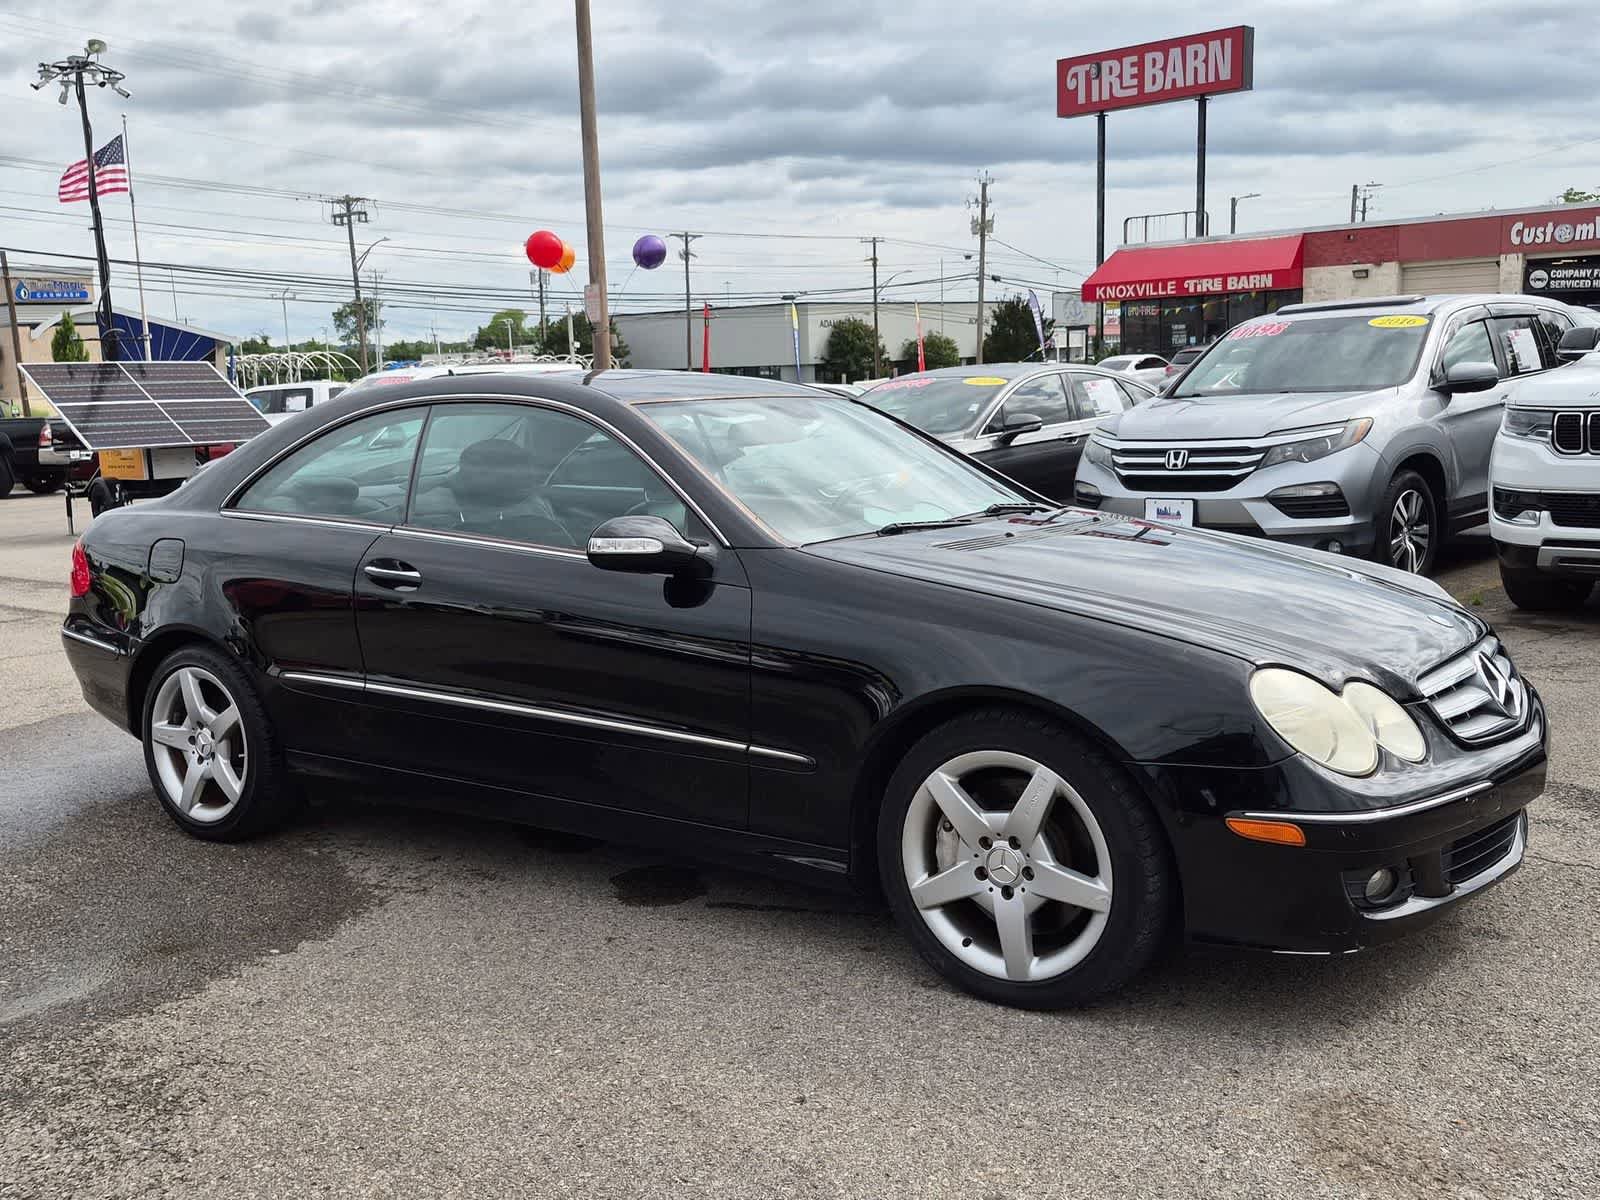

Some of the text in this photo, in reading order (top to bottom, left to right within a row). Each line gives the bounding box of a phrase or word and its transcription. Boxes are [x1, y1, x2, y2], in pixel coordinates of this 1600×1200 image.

[1144, 38, 1232, 94] BARN
[1511, 215, 1600, 245] Custom
[1096, 281, 1176, 299] KNOXVILLE
[1227, 273, 1272, 290] BARN
[1550, 269, 1592, 278] COMPANY
[1550, 280, 1592, 289] SERVICED
